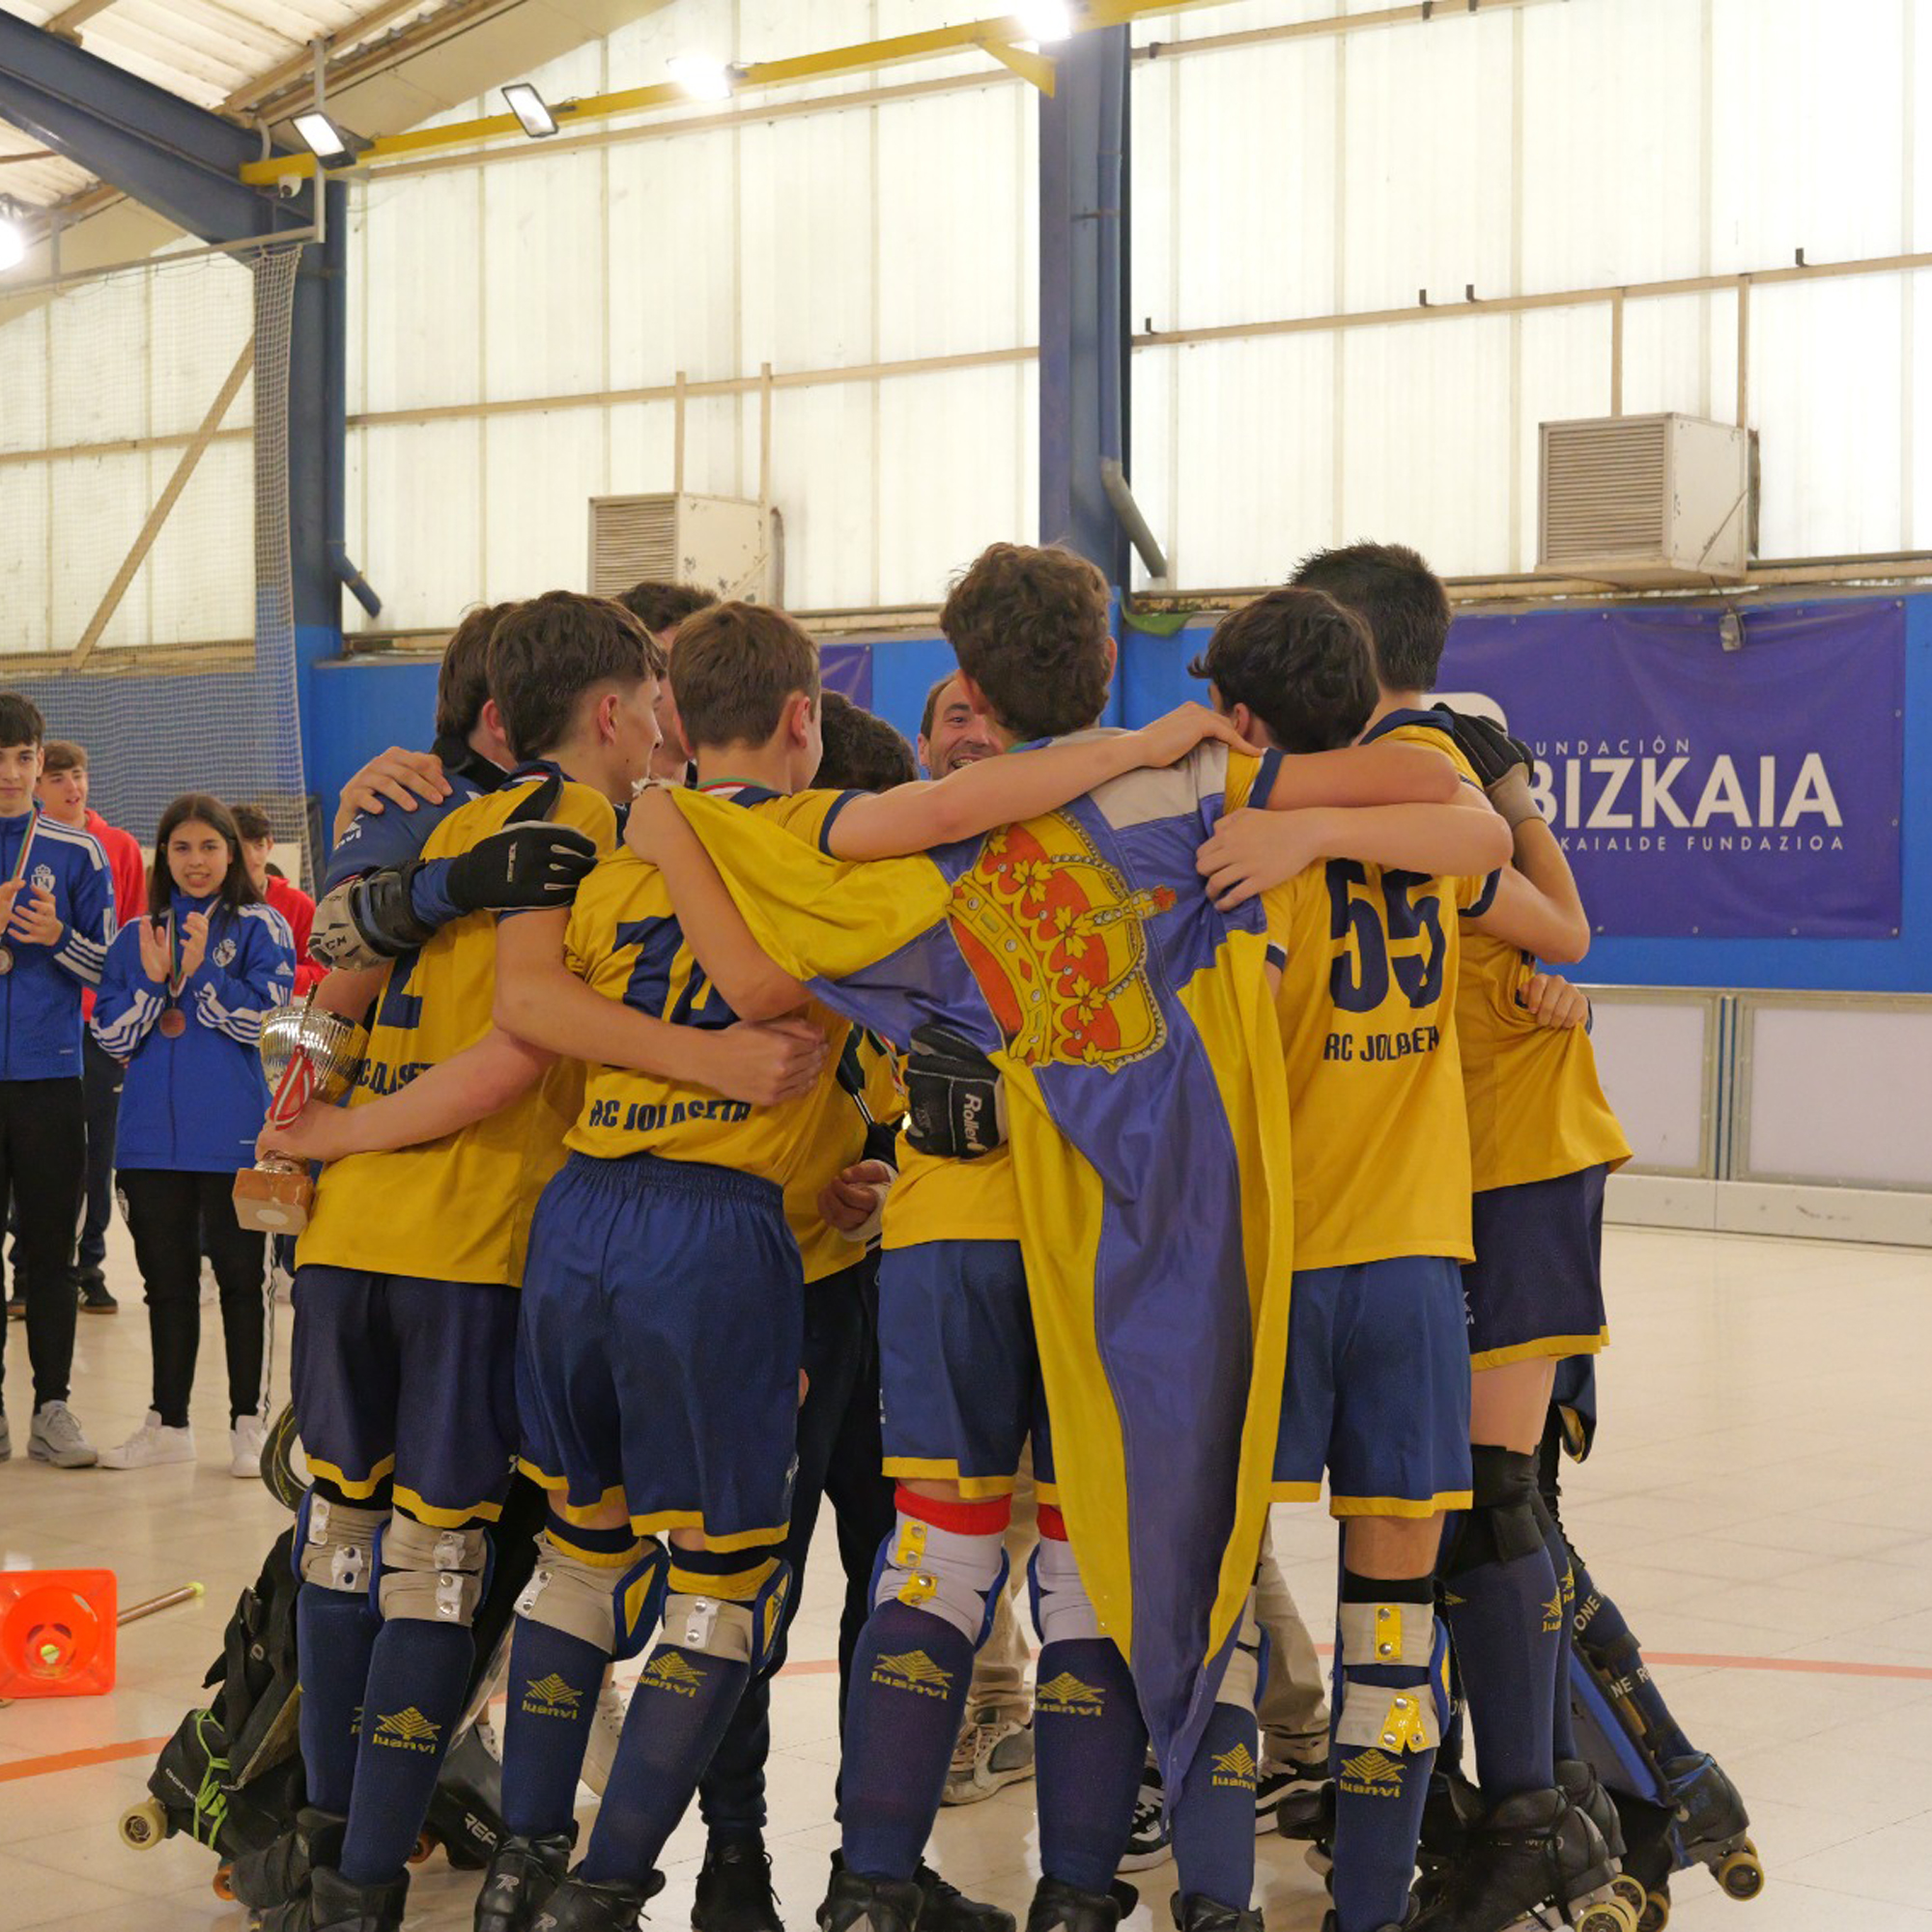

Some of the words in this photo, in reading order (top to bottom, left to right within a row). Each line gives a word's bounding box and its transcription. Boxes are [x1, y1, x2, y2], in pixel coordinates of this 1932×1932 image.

[1524, 735, 1690, 756] UNDACIÓN
[1530, 753, 1844, 829] BIZKAIA
[1560, 836, 1666, 851] KAIALDE
[1687, 836, 1844, 851] FUNDAZIOA
[1325, 858, 1446, 1012] 55
[1323, 1032, 1352, 1062] RC
[1573, 1595, 1601, 1632] ONE
[871, 1671, 948, 1700] luanvi
[1610, 1676, 1634, 1698] NE
[522, 1699, 578, 1720] luanvi
[1035, 1701, 1101, 1717] uanvi
[373, 1733, 436, 1754] luanvi
[1339, 1778, 1401, 1799] luanvi
